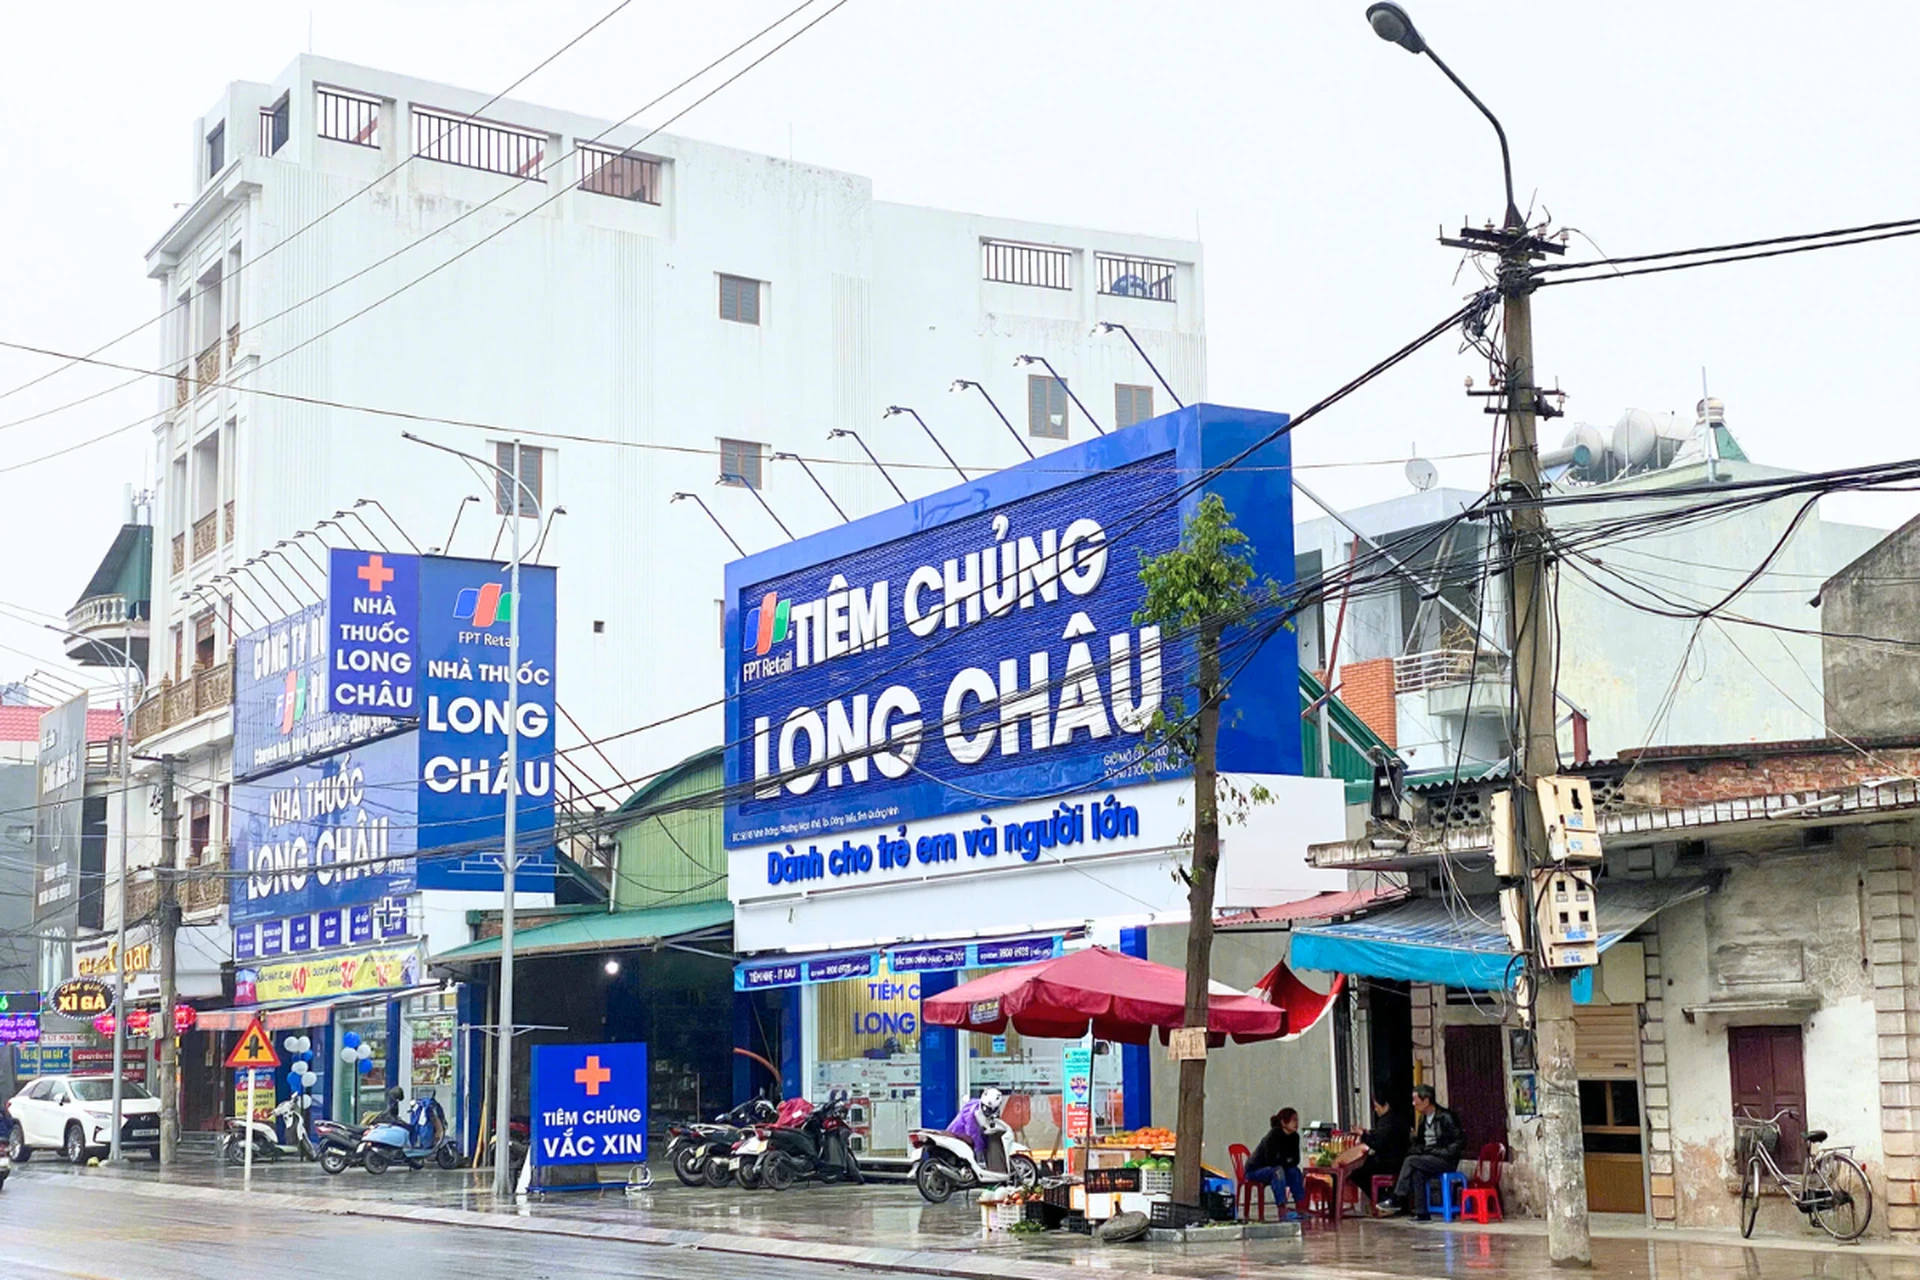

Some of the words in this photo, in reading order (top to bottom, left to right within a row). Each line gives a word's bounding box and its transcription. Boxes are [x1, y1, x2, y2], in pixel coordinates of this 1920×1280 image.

[353, 596, 397, 616] NHÀ
[791, 574, 889, 668] TIÊM
[903, 515, 1107, 637] CHỦNG
[340, 622, 410, 645] THUỐC
[458, 631, 481, 645] FPT
[484, 633, 519, 648] Retal
[337, 649, 412, 674] LONG
[428, 657, 473, 681] NHÀ
[478, 660, 550, 686] THUỐC
[743, 659, 760, 682] FPT
[762, 650, 793, 678] Retail
[335, 681, 413, 708] CHÂU
[754, 685, 924, 800] LONG
[942, 612, 1163, 764] CHÂU
[428, 695, 549, 738] LONG
[424, 752, 550, 797] CHÂU
[270, 776, 301, 828] NHÀ
[306, 754, 364, 819] THUỐC
[248, 836, 308, 900] LONG
[316, 808, 389, 886] CHÂU
[768, 844, 824, 885] Dành
[829, 840, 873, 877] cho
[877, 824, 911, 870] trẻ
[916, 832, 957, 864] em
[963, 814, 998, 857] và
[1004, 802, 1084, 863] người
[1091, 794, 1139, 841] lớn
[59, 994, 79, 1011] XÌ
[81, 993, 106, 1010] GÀ
[867, 980, 904, 1000] TIÊM
[854, 1012, 916, 1035] LONG
[543, 1107, 579, 1127] TIÊM
[583, 1104, 642, 1125] CHỦNG
[543, 1127, 595, 1158] VẮC
[602, 1132, 643, 1155] XIN
